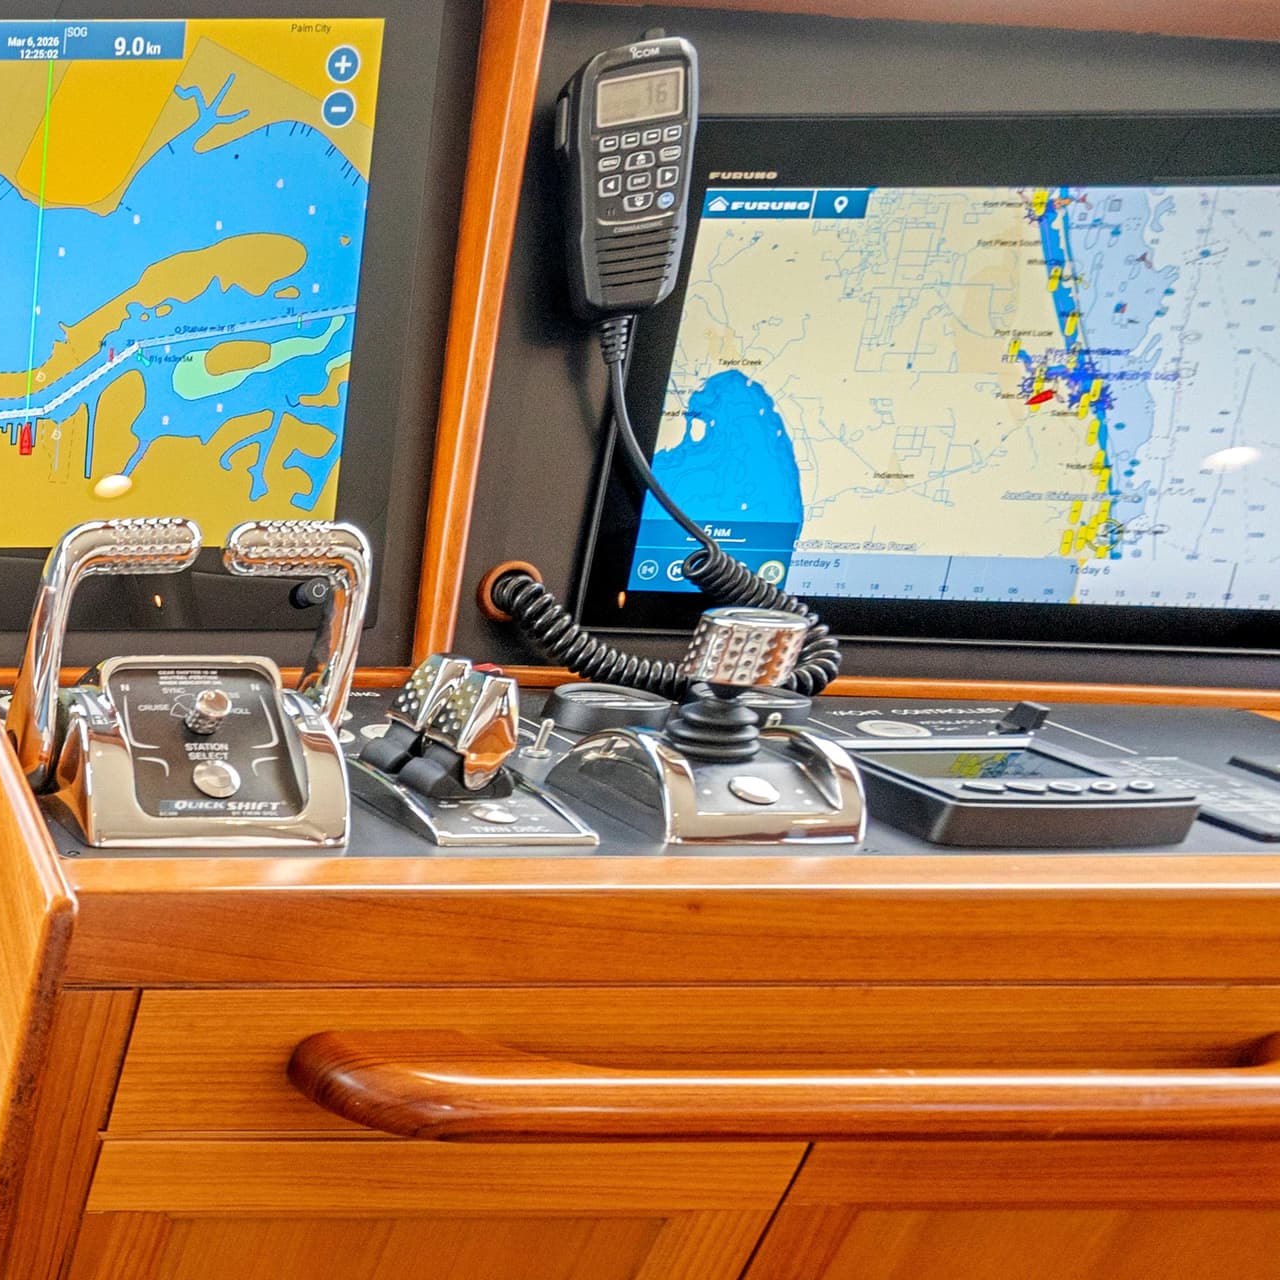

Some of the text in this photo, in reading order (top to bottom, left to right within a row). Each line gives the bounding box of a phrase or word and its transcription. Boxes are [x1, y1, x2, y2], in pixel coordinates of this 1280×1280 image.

[68, 27, 88, 38] SOG
[291, 24, 331, 34] Palm City
[8, 36, 59, 48] Mar 6, 2026
[114, 38, 161, 56] 9.0 kn
[709, 172, 777, 180] FURUNO
[731, 202, 809, 210] FURUNO
[714, 528, 731, 536] NM
[184, 743, 228, 751] STATION
[188, 752, 228, 760] SELECT
